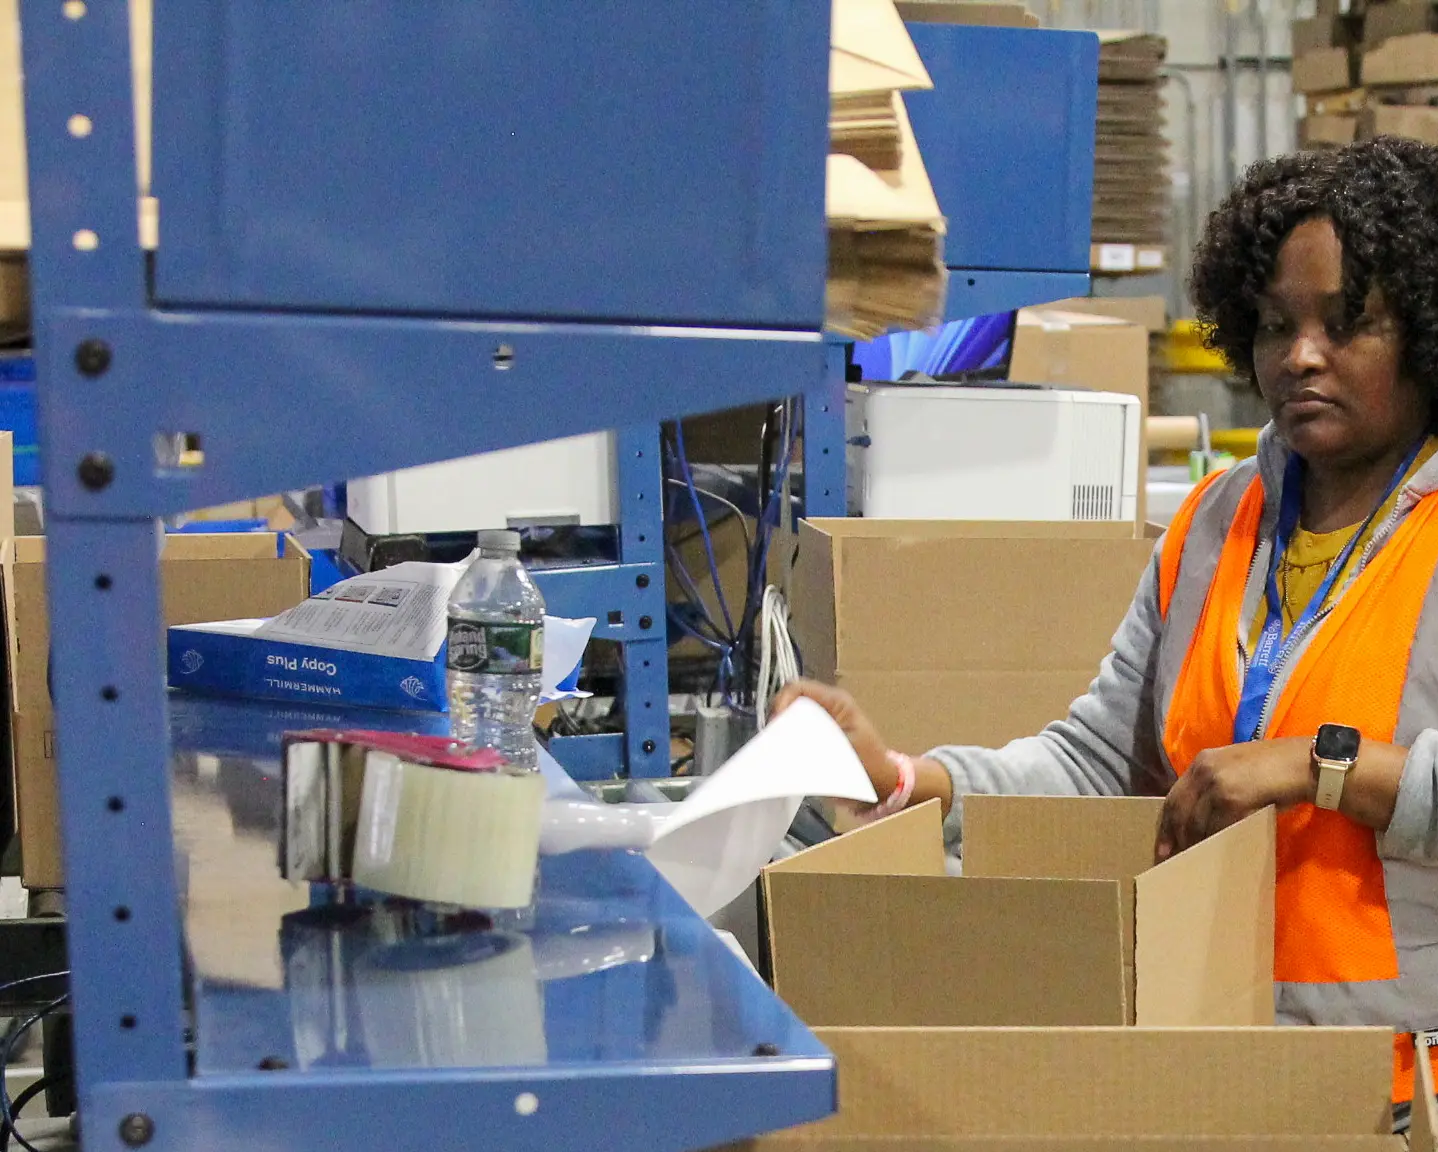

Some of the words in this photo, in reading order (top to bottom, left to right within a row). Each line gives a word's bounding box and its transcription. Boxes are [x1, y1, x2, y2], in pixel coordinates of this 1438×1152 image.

[1259, 632, 1278, 667] Barrett
[266, 654, 298, 671] Plus
[301, 657, 337, 676] Copy
[266, 678, 342, 696] HAMMERMILL
